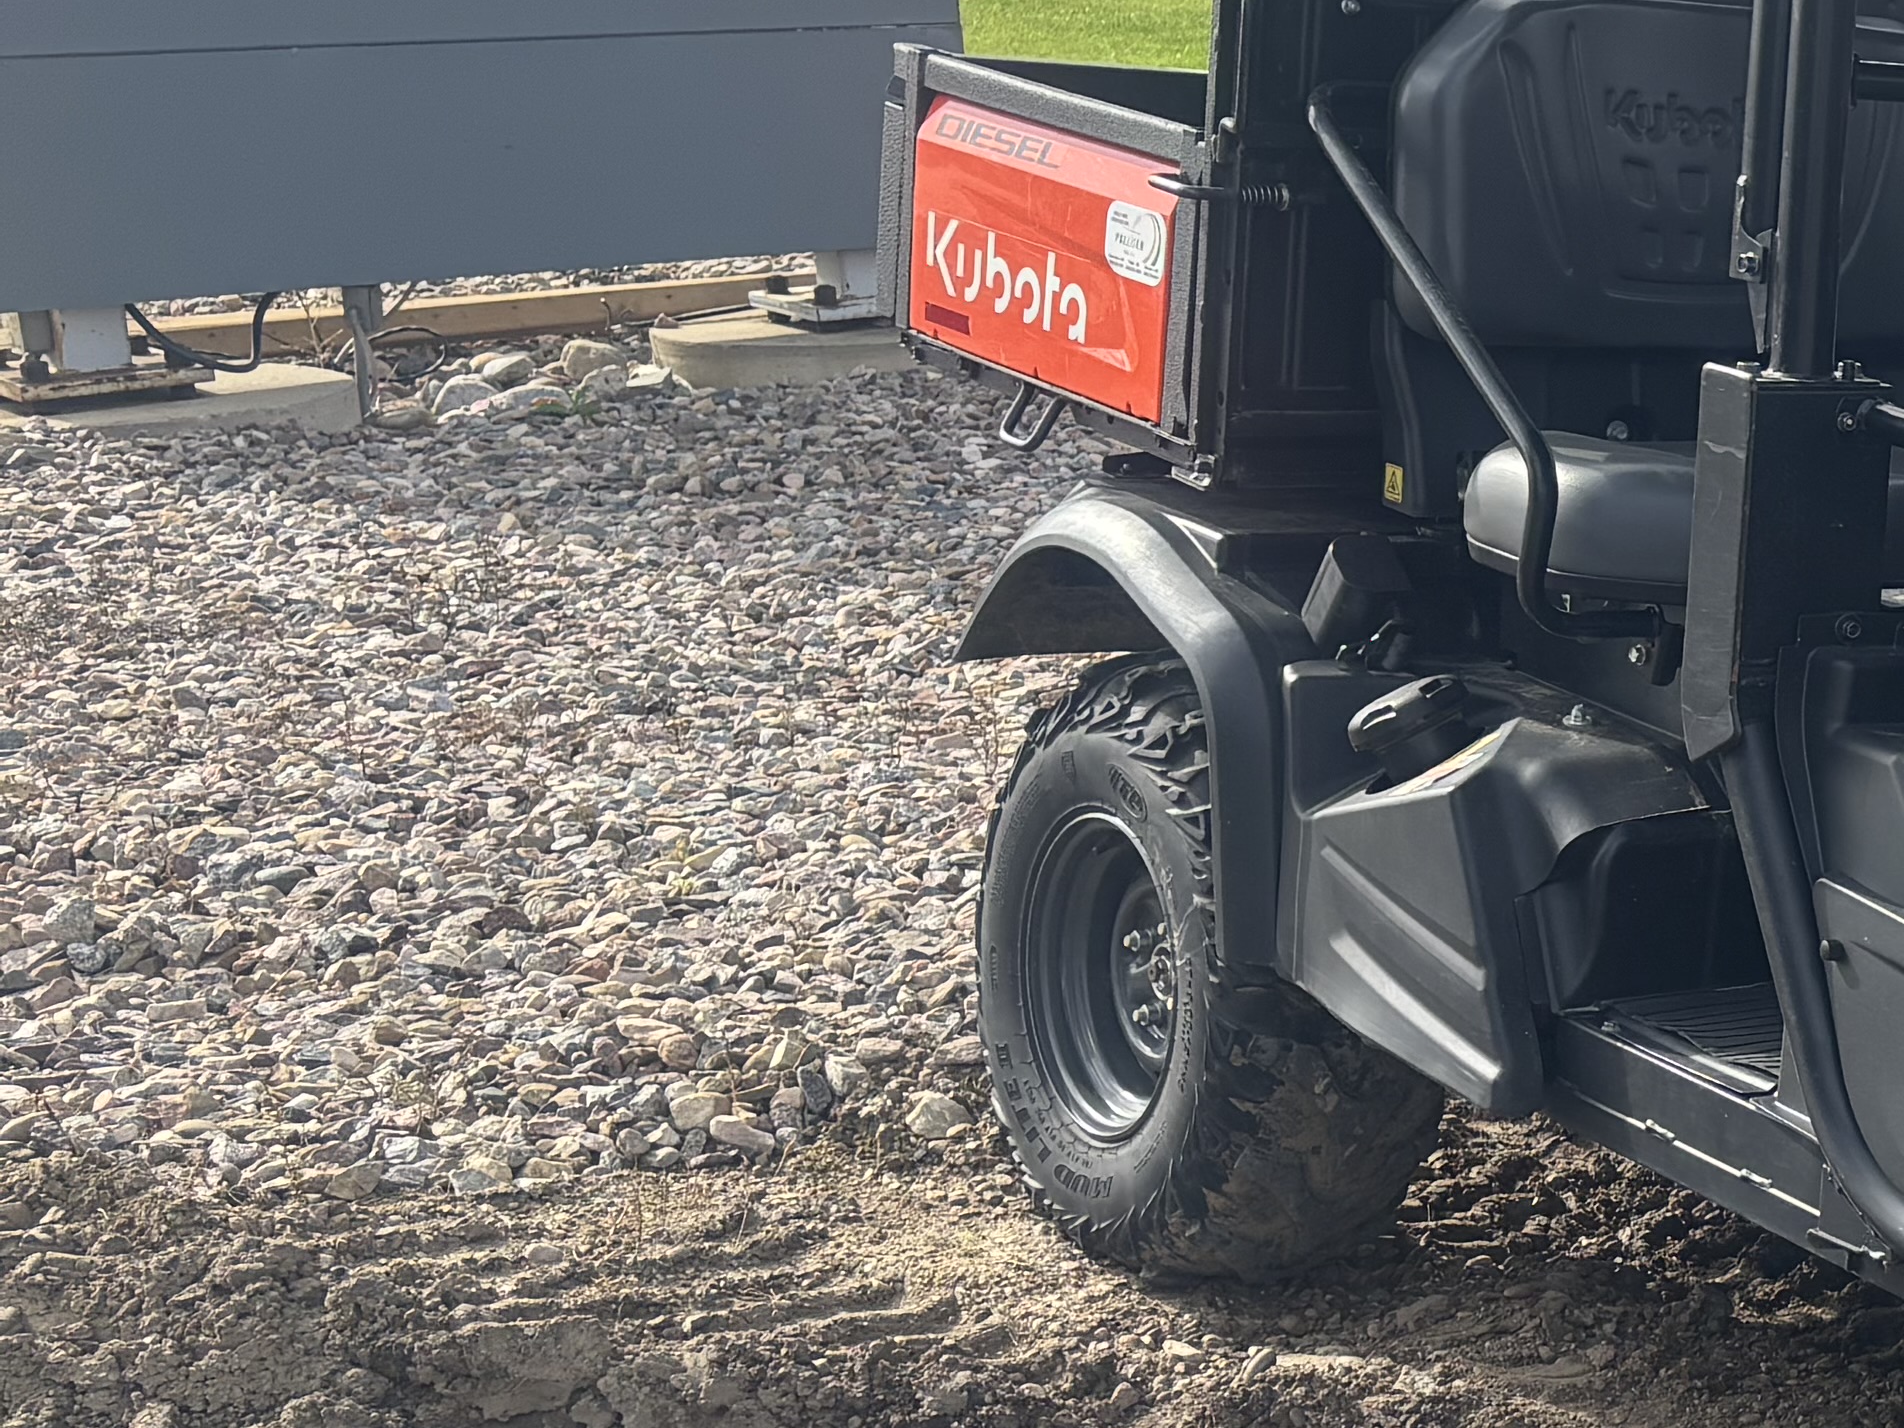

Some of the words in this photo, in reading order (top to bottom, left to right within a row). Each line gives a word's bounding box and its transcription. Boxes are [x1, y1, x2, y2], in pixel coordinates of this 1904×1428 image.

[935, 113, 1062, 170] DIESEL
[926, 209, 1088, 344] Kubota
[1003, 1077, 1052, 1164] LITE
[1053, 1163, 1115, 1199] MUD
